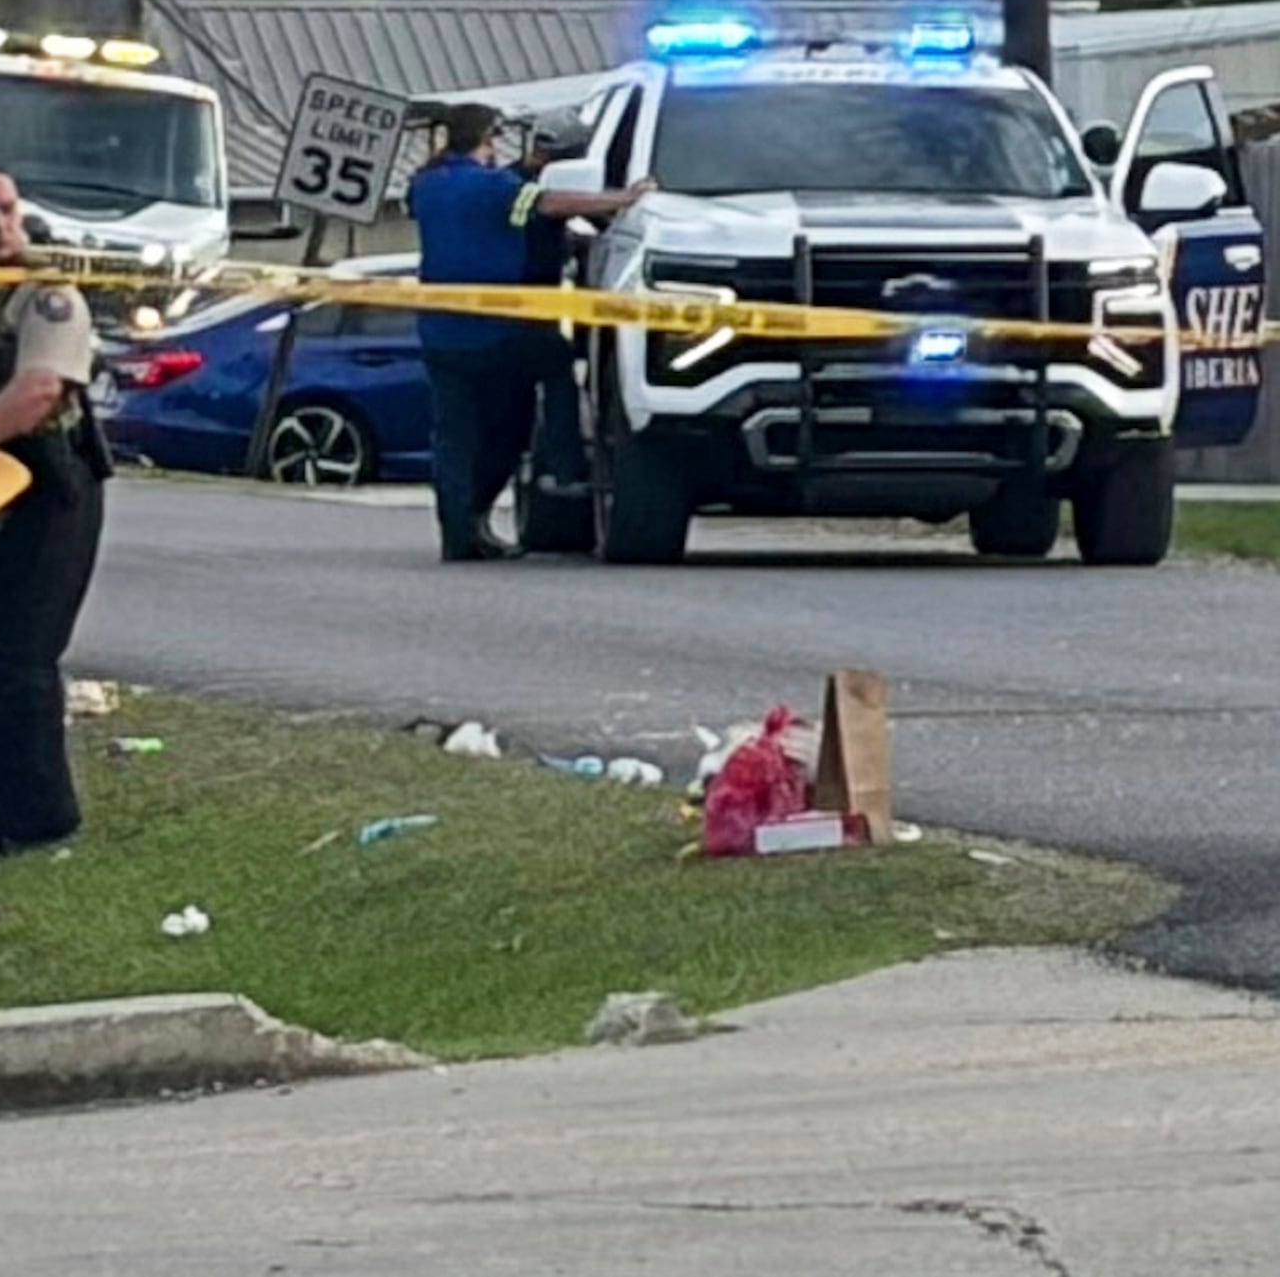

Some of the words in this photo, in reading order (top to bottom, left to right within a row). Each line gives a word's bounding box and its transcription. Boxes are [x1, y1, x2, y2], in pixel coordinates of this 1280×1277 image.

[309, 88, 396, 130] SPEED
[311, 118, 381, 154] LIMIT
[292, 145, 373, 206] 35
[1186, 286, 1260, 349] SHE
[1185, 357, 1260, 389] IBERIA
